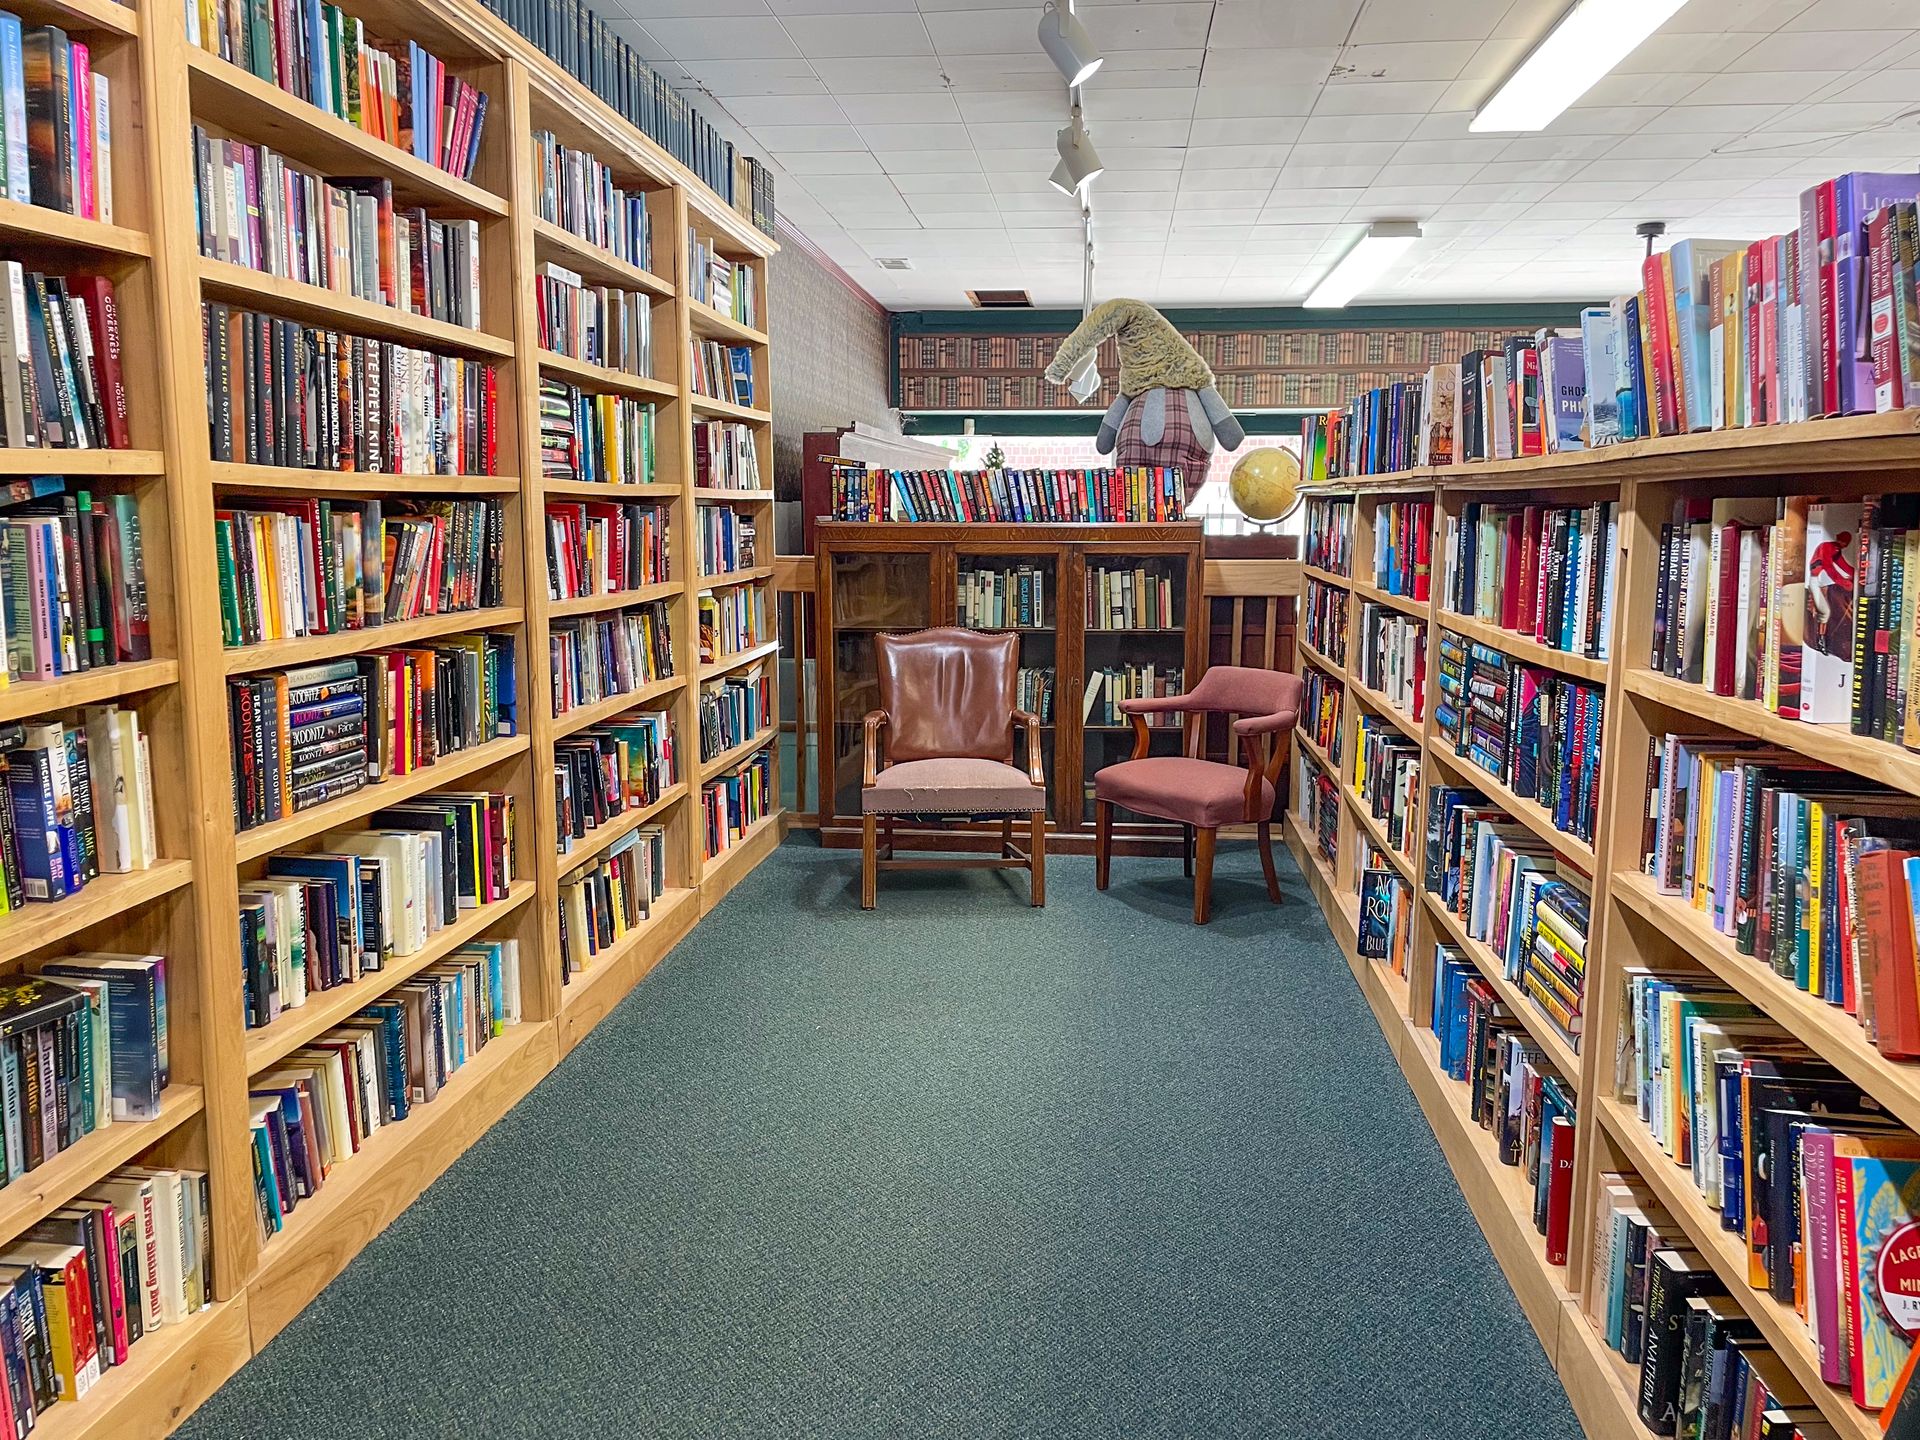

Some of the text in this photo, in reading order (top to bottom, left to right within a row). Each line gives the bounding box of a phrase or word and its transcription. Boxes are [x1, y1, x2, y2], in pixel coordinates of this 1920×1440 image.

[1881, 224, 1889, 239] We
[1881, 241, 1889, 261] Need
[1872, 247, 1881, 297] About Kevin
[1881, 272, 1889, 291] Talk
[38, 282, 58, 356] PAUL HOFFMAN
[105, 296, 117, 360] GOVERNESS
[219, 311, 227, 360] STEPHEN
[263, 321, 272, 384] STEPHEN KING
[413, 357, 421, 397] KING
[1873, 345, 1882, 379] Shriver
[1881, 342, 1889, 371] Lionel
[115, 382, 124, 418] HOLDEN
[368, 340, 380, 472] STEPHEN KING
[131, 516, 142, 570] GREG
[1669, 526, 1680, 581] FLASHBACK
[124, 522, 140, 620] MISSISSIPPI BLOOD
[1021, 577, 1029, 606] SINCLAIR
[1537, 570, 1545, 624] PLEASURES
[1895, 566, 1903, 621] ALEXANDER
[1852, 597, 1868, 708] MARTIN CRUZ SMITH
[1896, 628, 1908, 714] JANE SMILEY
[241, 693, 252, 752] KOONTZ
[291, 690, 319, 704] KOONTZ
[52, 730, 66, 766] JOHN
[255, 725, 263, 764] KOONTZ
[295, 726, 325, 743] KOONTZ
[338, 723, 354, 734] Face
[1573, 694, 1583, 757] JOHN SAUL
[299, 750, 322, 762] KOONTZ
[39, 758, 55, 827] MICHELE JAFFE
[76, 759, 90, 813] THE BISHOP
[77, 831, 86, 864] JAMES
[84, 827, 95, 856] JAMES
[1740, 776, 1753, 894] ALEXANDER McCALL SMITH
[1796, 816, 1805, 875] LEE SMITH
[1810, 820, 1820, 884] LEE SMITH
[49, 858, 58, 882] GIRL
[56, 857, 64, 878] BAD
[1726, 847, 1734, 896] ALEXANDER
[1777, 832, 1786, 935] ON AGATE HILL
[1525, 905, 1534, 950] SCOTTOLINE
[4, 1065, 17, 1119] Jardine
[26, 1059, 40, 1114] Jardine
[42, 1045, 53, 1098] Jardine
[1818, 1144, 1829, 1260] COLLECTED STORIES
[143, 1196, 160, 1317] Arrest Sitting Bull
[1841, 1226, 1849, 1255] LAGER
[18, 1290, 36, 1342] DESCENT
[1649, 1264, 1661, 1321] STEPHENSON
[1657, 1286, 1665, 1309] NEAL
[1845, 1289, 1852, 1299] OF
[1846, 1302, 1855, 1358] MINNESOTA
[1643, 1328, 1659, 1405] ANATHEM
